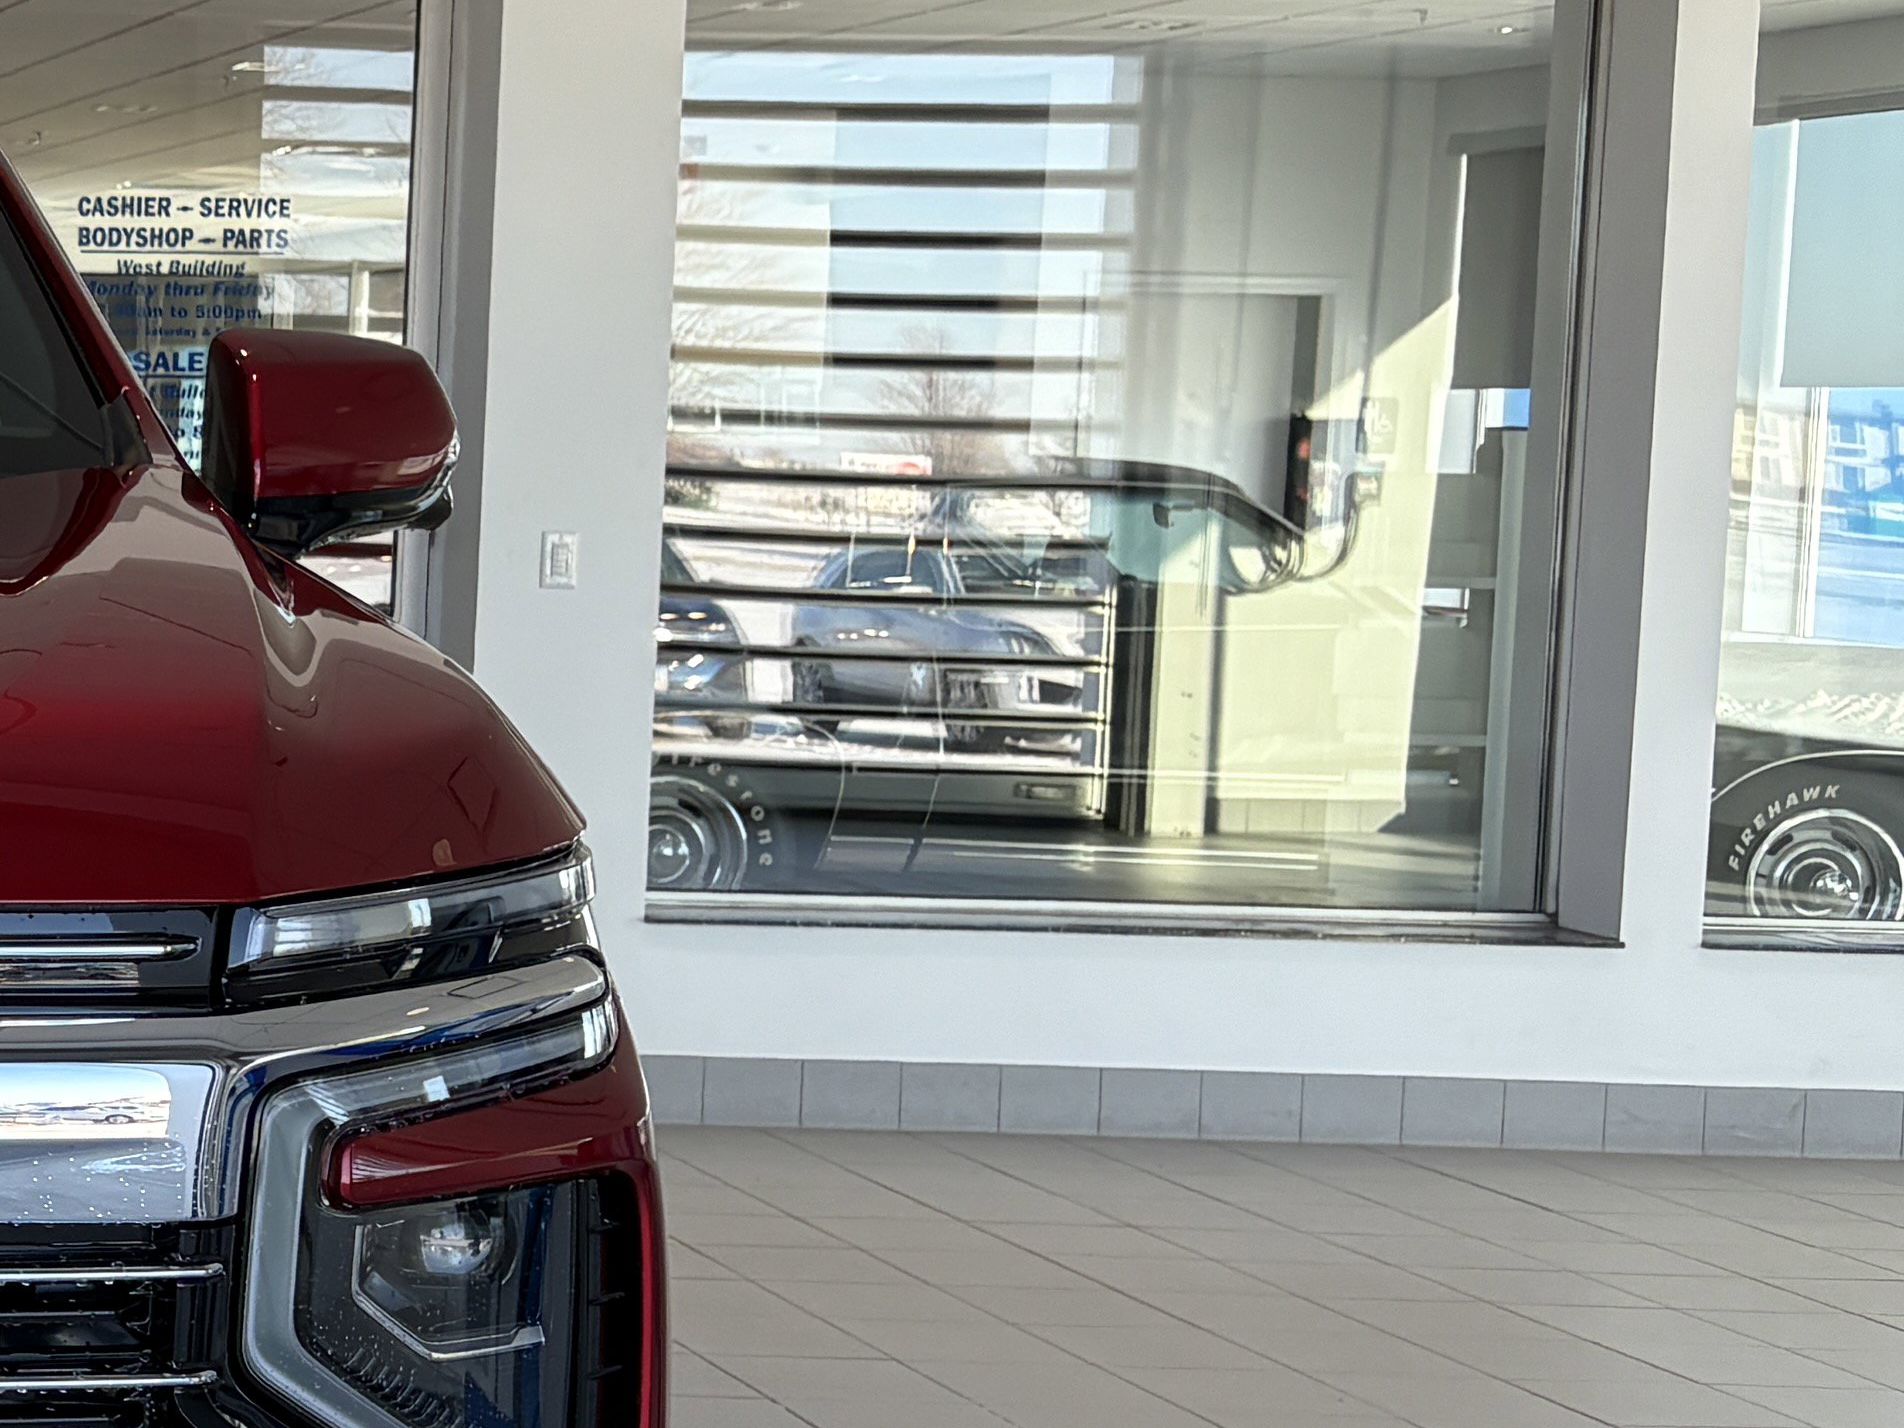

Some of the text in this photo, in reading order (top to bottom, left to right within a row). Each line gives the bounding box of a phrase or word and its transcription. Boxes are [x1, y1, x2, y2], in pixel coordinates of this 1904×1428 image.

[78, 196, 171, 218] CASHIER
[199, 197, 291, 219] SERVICE
[78, 226, 194, 248] BODYSHOP
[222, 228, 289, 249] PARTS
[117, 259, 247, 278] West Building
[171, 306, 188, 319] to
[1728, 784, 1840, 872] FIREHAWK
